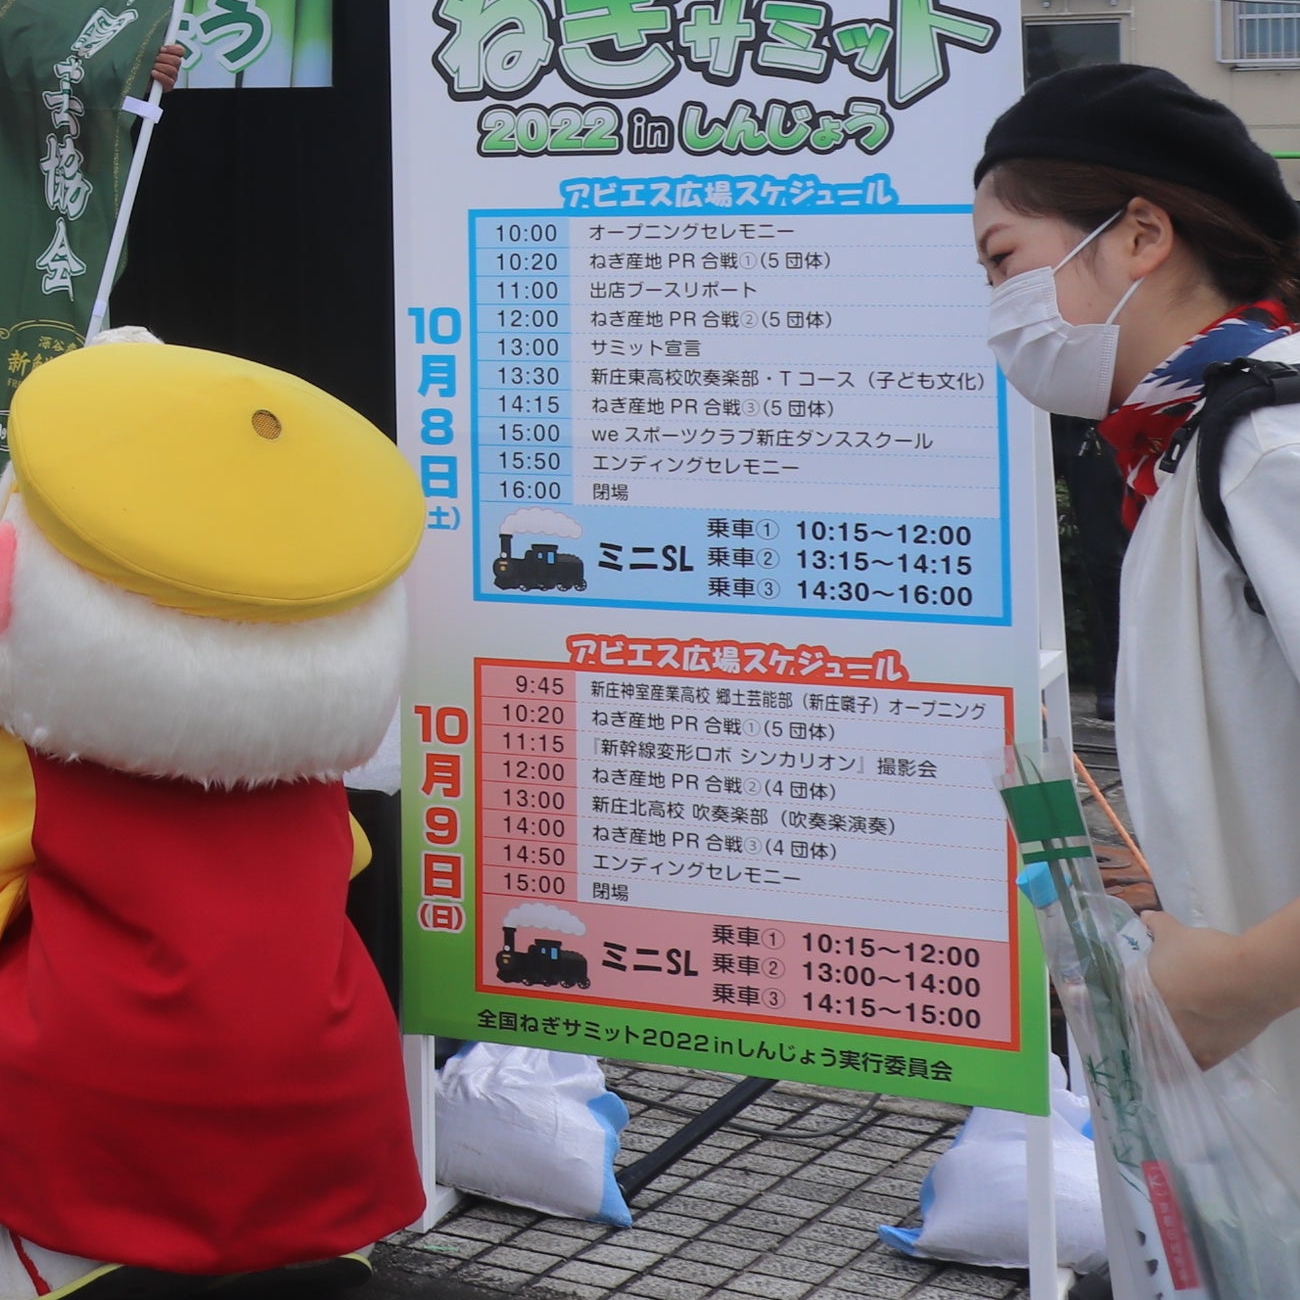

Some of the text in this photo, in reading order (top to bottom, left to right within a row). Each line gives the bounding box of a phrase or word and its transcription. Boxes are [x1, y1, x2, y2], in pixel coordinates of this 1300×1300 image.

[479, 102, 894, 155] 2022 in しんじょう
[564, 179, 894, 209] アビエス広場スケジュール
[496, 222, 795, 242] 10:00 オープニングセレモニー
[497, 252, 558, 271] 10:20
[497, 281, 757, 300] 11:00 出店ブースリポート
[497, 310, 559, 328] 12:00
[498, 338, 702, 358] 13:00 サミット宣言
[498, 367, 560, 386] 13:30
[498, 395, 560, 414] 14:15
[407, 307, 463, 530] 10月8日土)
[498, 424, 560, 442] 15:00
[498, 452, 800, 476] 15:50 エンディングセレモニー
[499, 480, 629, 501] 16:00 閉場
[707, 516, 972, 547] 乗車① 10:15～12:00
[598, 541, 695, 572] ミニSL
[707, 546, 973, 576] 乗車② 13:15～14:15
[708, 576, 974, 607] 乗車③ 14:30～16:00
[571, 639, 904, 681] アビエス広場スケジュール
[515, 675, 565, 696] 9:45
[502, 704, 565, 725] 10:20
[502, 732, 565, 753] 11:15
[503, 761, 565, 782] 12:00
[503, 789, 566, 810] 13:00
[592, 796, 685, 819] 新庄北高校
[503, 817, 566, 838] 14:00
[503, 845, 801, 884] 14:50 エンディングセレモニー
[503, 873, 629, 902] 15:00 閉場
[712, 923, 981, 968] 乗車① 10:15～12:00
[601, 941, 699, 977] ミニSL
[712, 952, 981, 998] 乗車② 13:00～14:00
[712, 982, 982, 1030] 乗車③ 14:15～15:00
